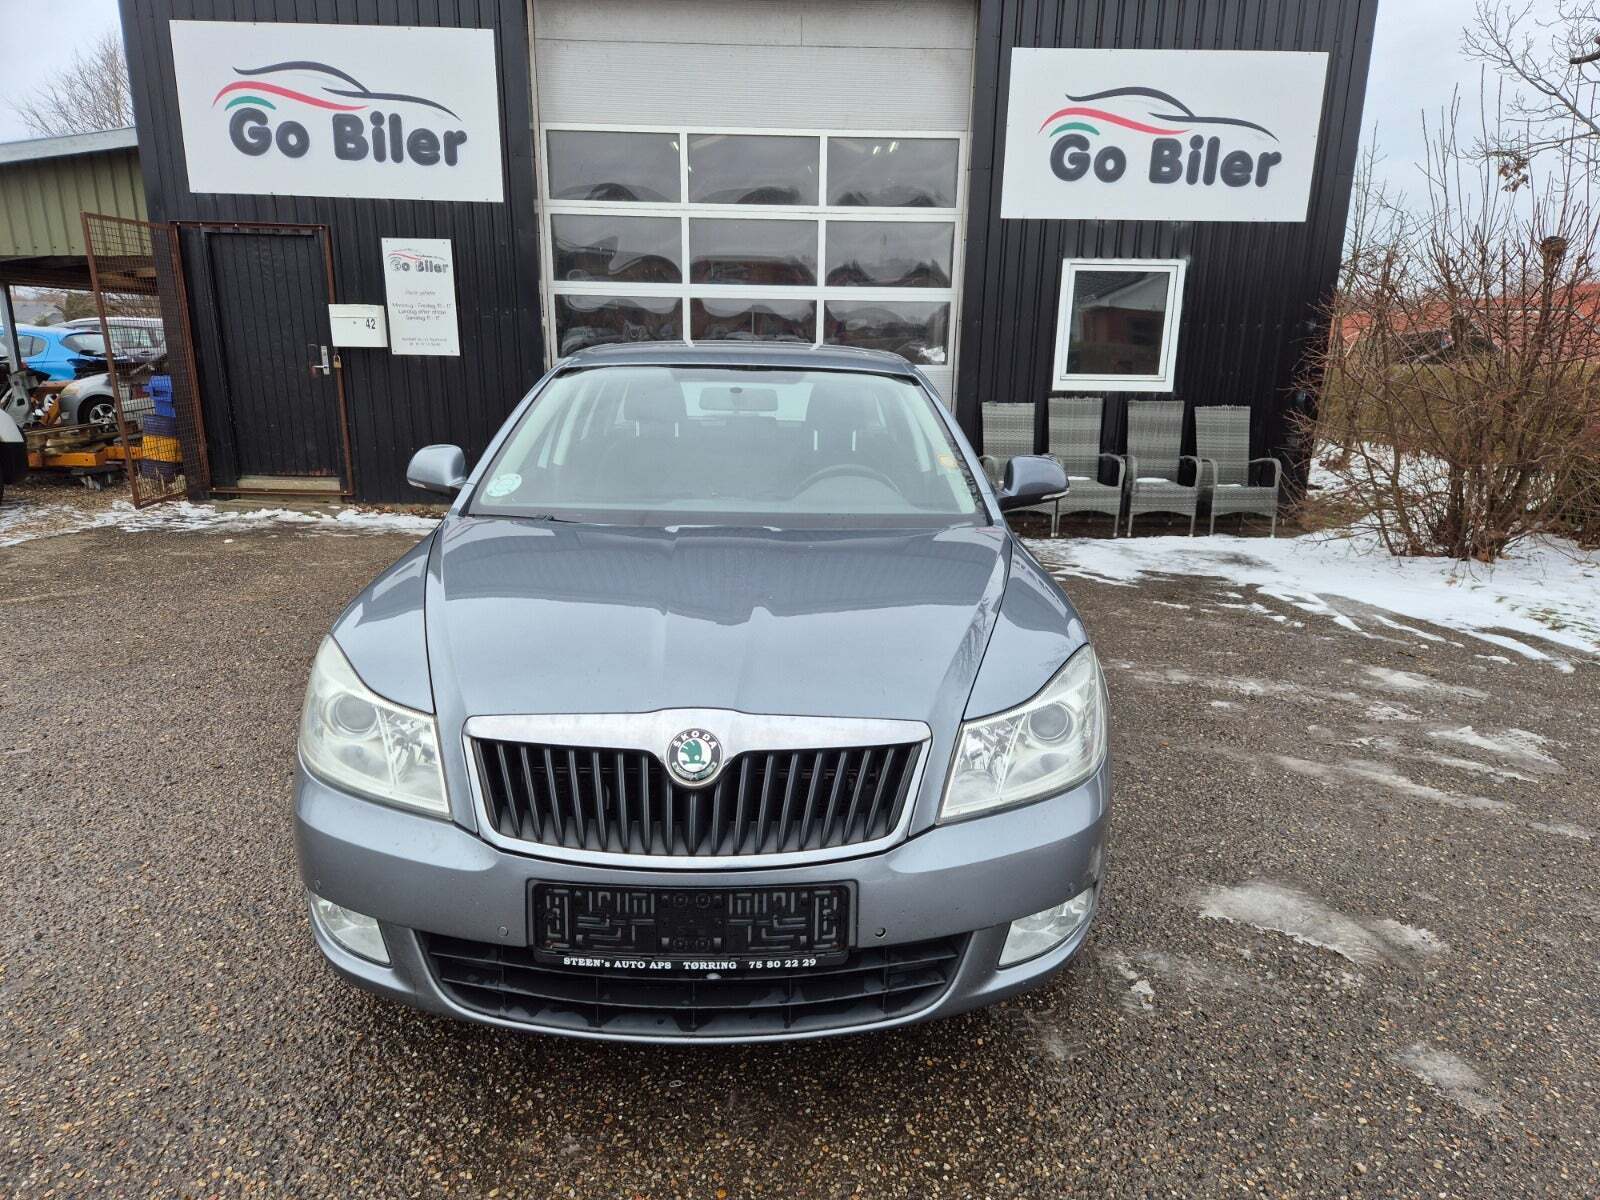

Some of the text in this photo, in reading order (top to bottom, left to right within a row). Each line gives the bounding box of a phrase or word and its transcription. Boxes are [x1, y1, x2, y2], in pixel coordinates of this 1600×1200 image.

[229, 107, 467, 167] Go Biler
[1050, 133, 1282, 188] Go Biler
[416, 259, 448, 273] Biler
[365, 318, 376, 330] 42
[563, 957, 817, 970] STEEN's AUTO APS TØRRING 75 80 22 29
